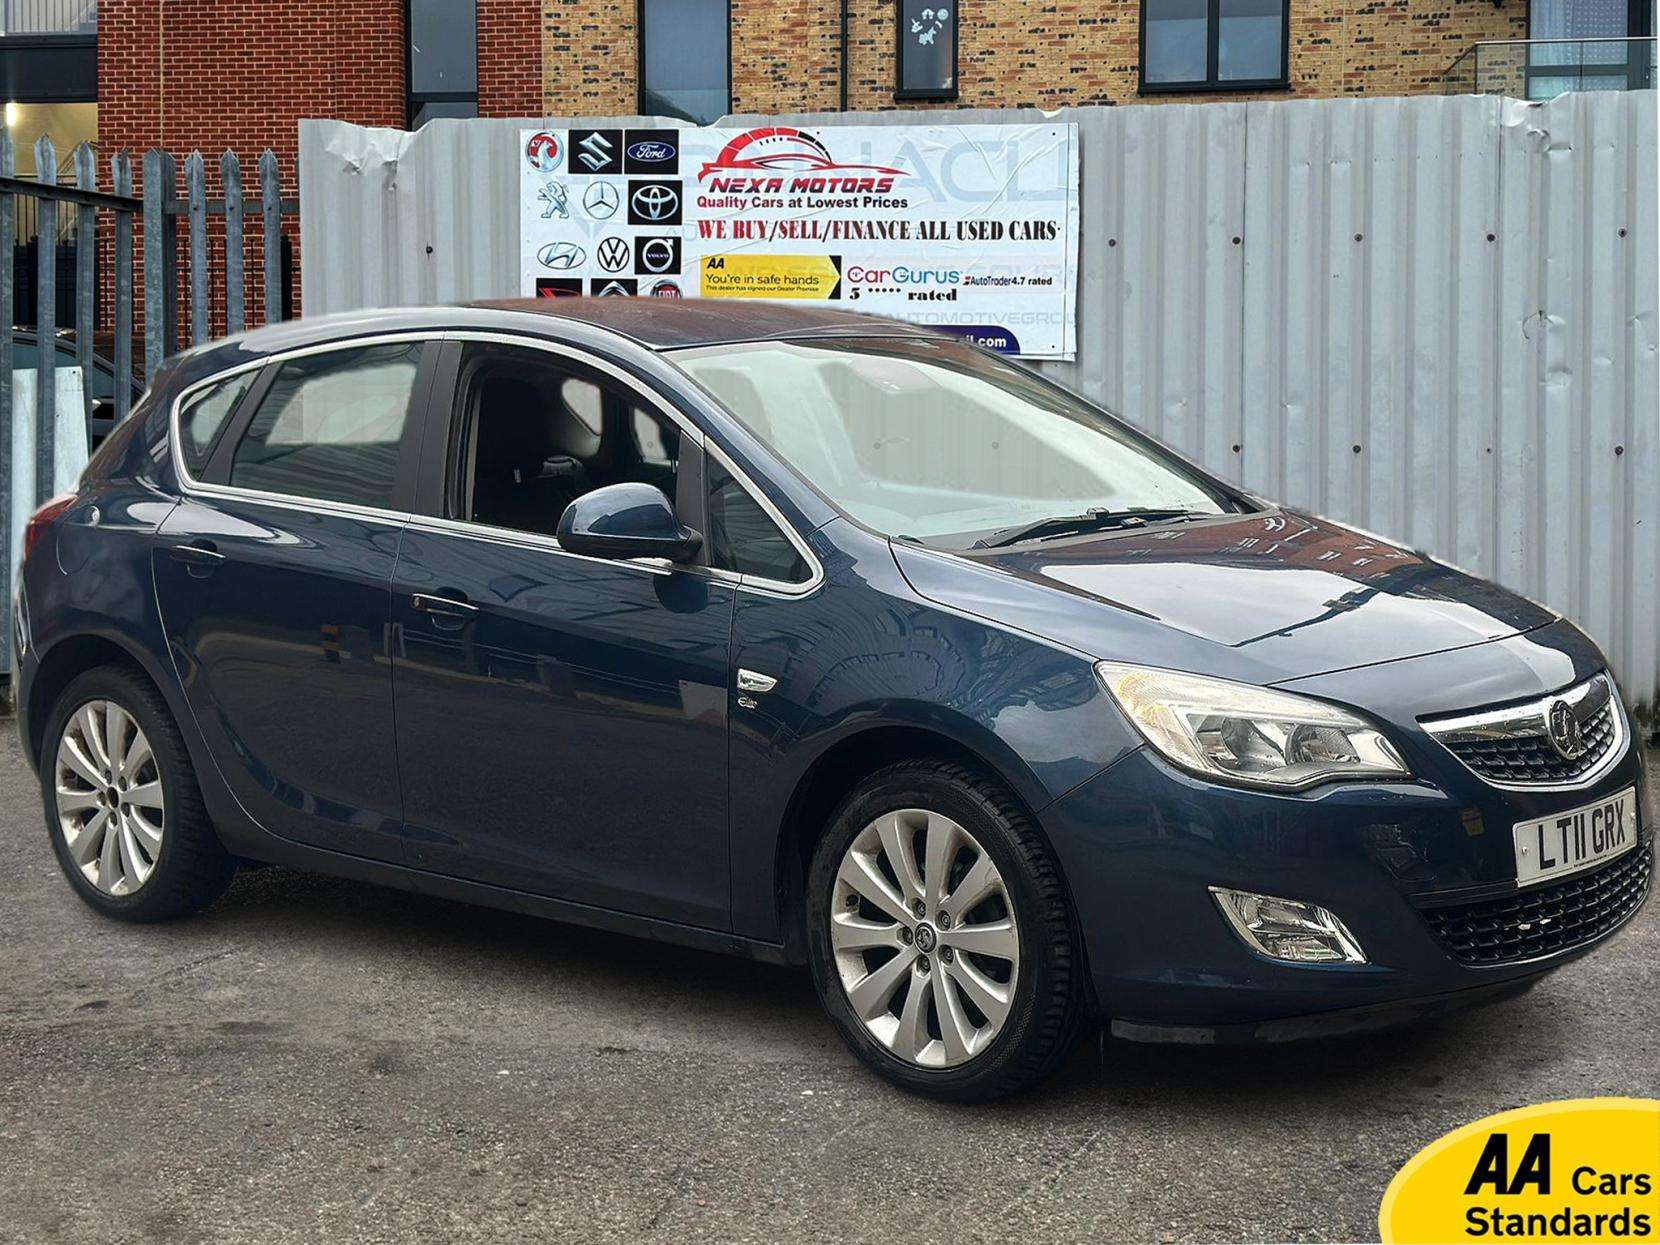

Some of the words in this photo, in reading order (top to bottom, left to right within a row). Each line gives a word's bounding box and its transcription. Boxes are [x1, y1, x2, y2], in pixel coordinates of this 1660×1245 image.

[636, 144, 666, 158] Ford
[709, 178, 784, 193] NEXA
[789, 178, 894, 193] MOTORS
[696, 196, 748, 210] Quality
[751, 196, 784, 208] Cars
[788, 197, 803, 208] at
[807, 196, 859, 208] Lowest
[863, 196, 908, 208] Prices
[697, 220, 727, 240] WE
[916, 221, 951, 240] ALL
[956, 221, 1004, 240] USED
[1008, 221, 1057, 240] CARS
[706, 257, 725, 269] AA
[706, 273, 741, 284] You're
[744, 274, 754, 284] in
[757, 274, 781, 285] safe
[783, 275, 820, 286] hands
[847, 266, 960, 284] CarGurus
[1028, 277, 1053, 286] rated
[849, 287, 860, 300] 5
[907, 288, 958, 300] rated
[1591, 799, 1626, 855] GRX
